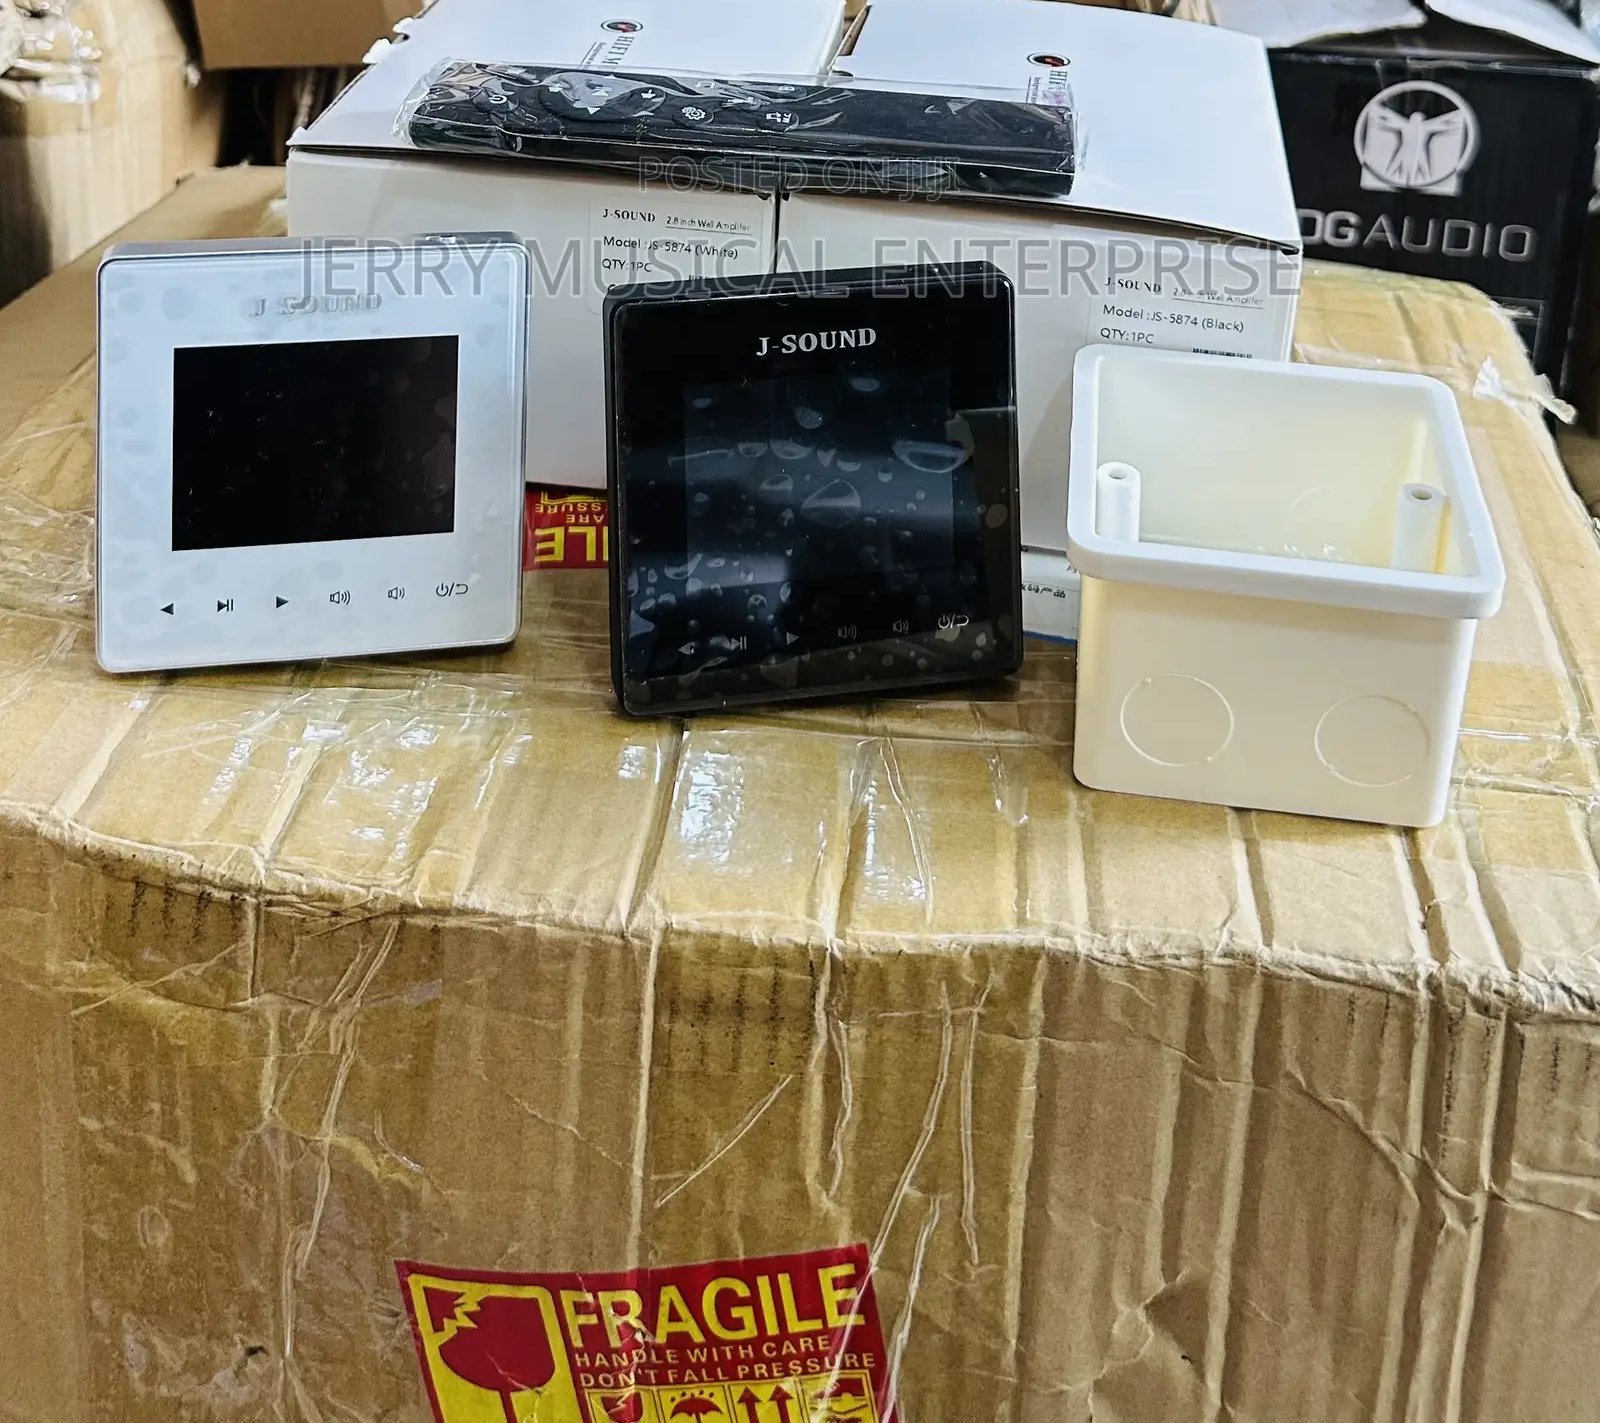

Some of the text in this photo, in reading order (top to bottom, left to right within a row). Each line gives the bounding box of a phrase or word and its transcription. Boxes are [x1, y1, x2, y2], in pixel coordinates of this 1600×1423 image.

[602, 208, 656, 222] J-SOUND
[603, 235, 641, 249] Model
[695, 244, 739, 260] (White)
[1104, 276, 1162, 293] J-SOUND
[1103, 304, 1144, 320] Model
[1201, 316, 1244, 333] (Black)
[756, 327, 877, 356] J-SOUND
[534, 502, 602, 514] SSURE
[565, 513, 605, 524] ARE
[559, 1262, 866, 1349] FRAGILE
[575, 1334, 832, 1368] HANDLE WITH CARE
[580, 1351, 877, 1388] DON'T FALL PRESSURE
